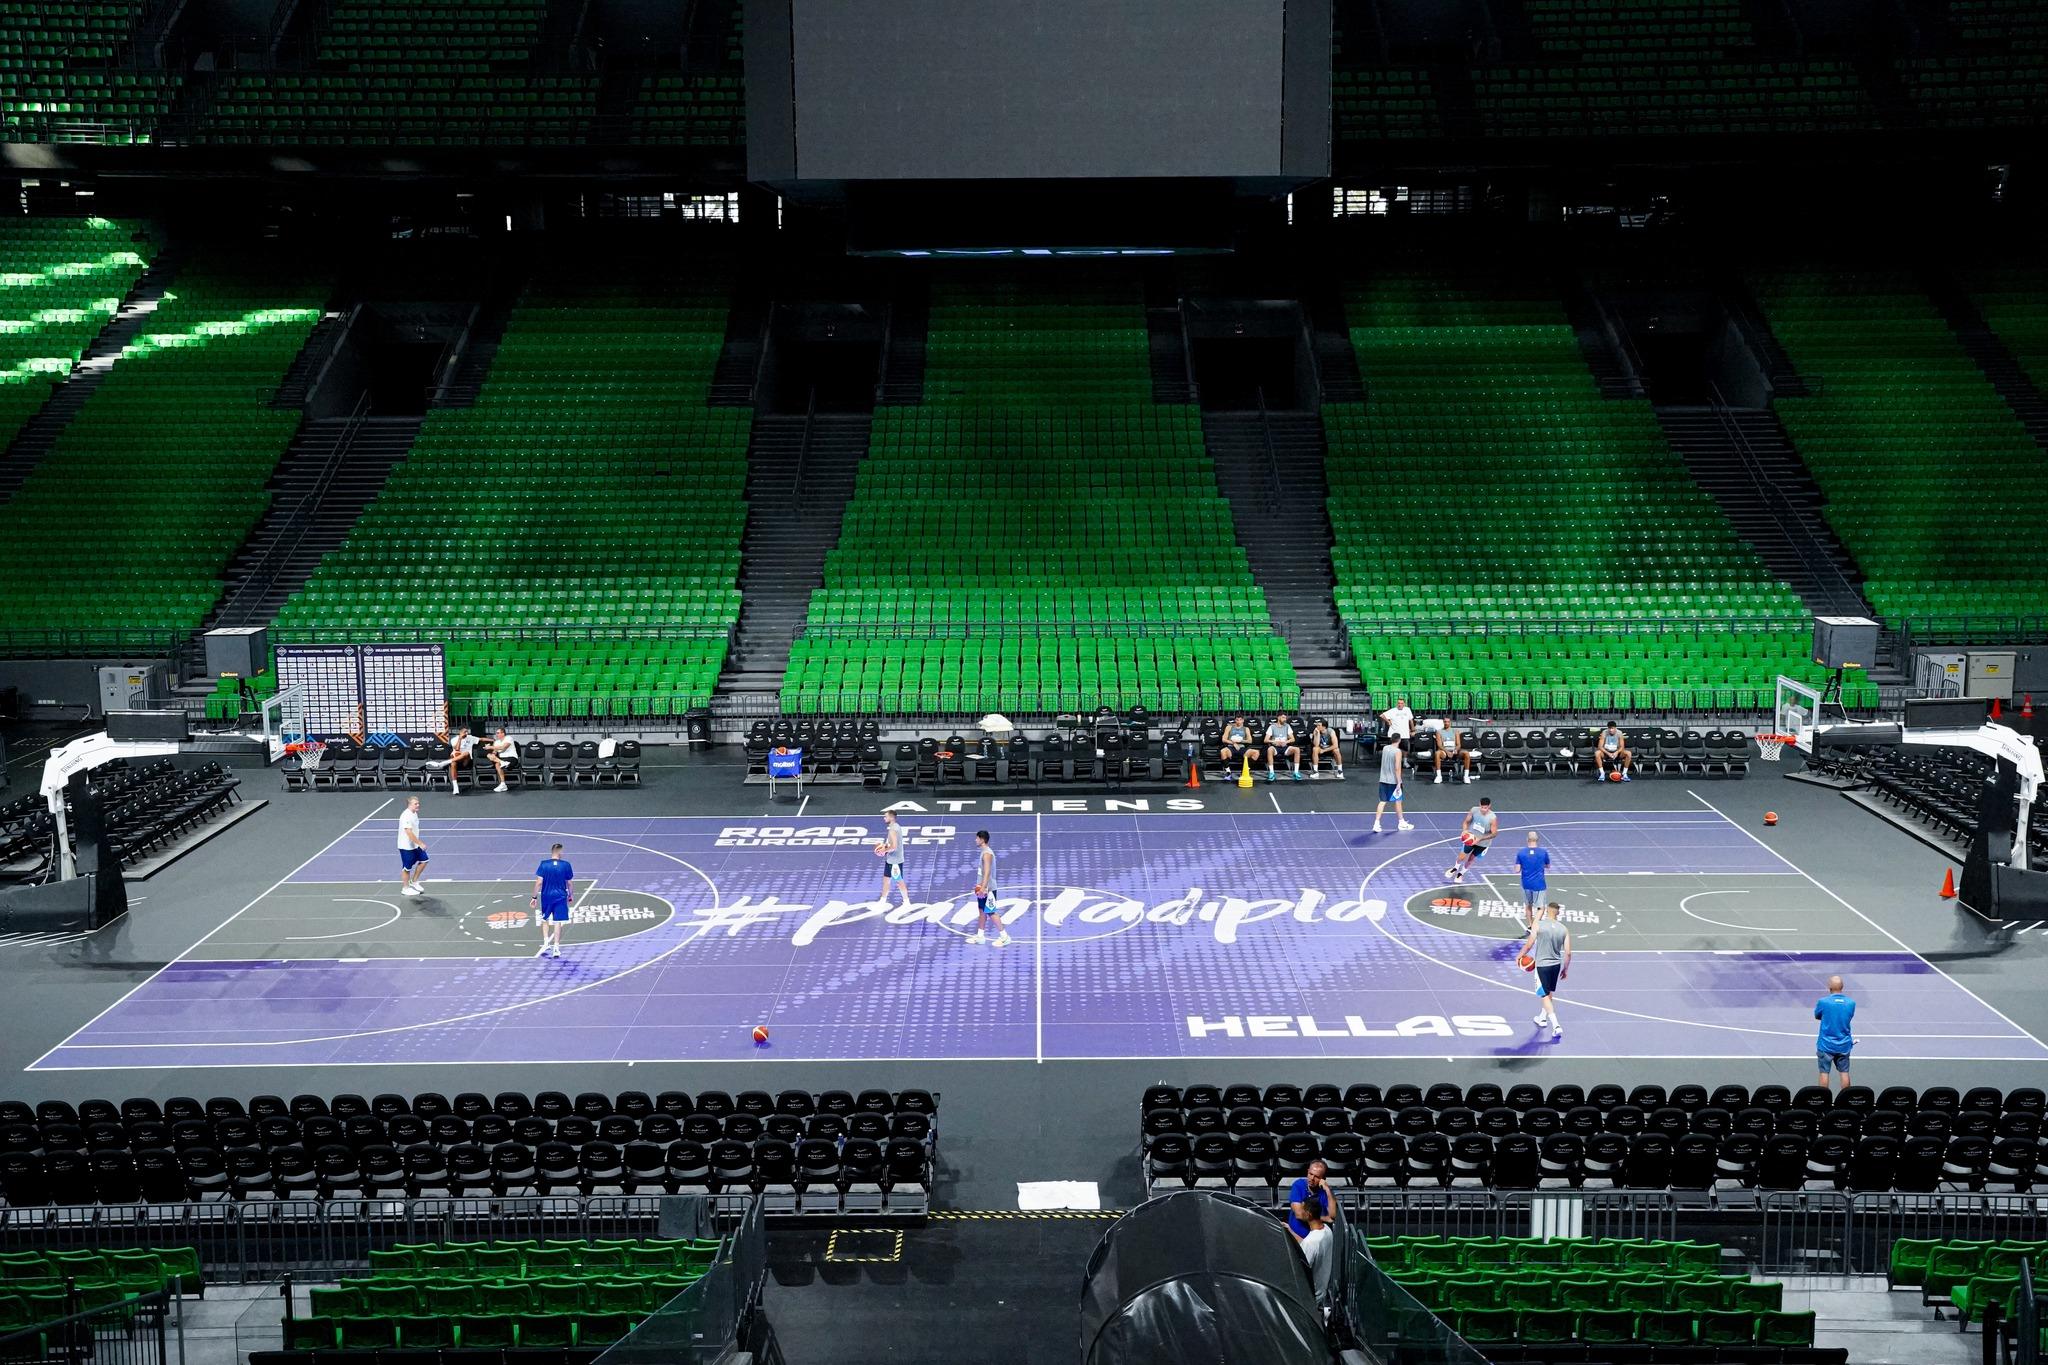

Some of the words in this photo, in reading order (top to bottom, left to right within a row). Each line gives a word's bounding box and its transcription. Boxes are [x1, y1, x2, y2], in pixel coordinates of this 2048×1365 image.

[880, 800, 1205, 812] ATHENS
[719, 826, 868, 838] ROAD
[887, 826, 956, 837] TO
[535, 907, 654, 921] KETBALL
[675, 888, 1388, 945] #pantadipla
[1477, 909, 1600, 924] FEDETION
[1478, 904, 1599, 918] BASKALL
[536, 912, 656, 926] FERATION
[1186, 1015, 1515, 1037] HELLAS
